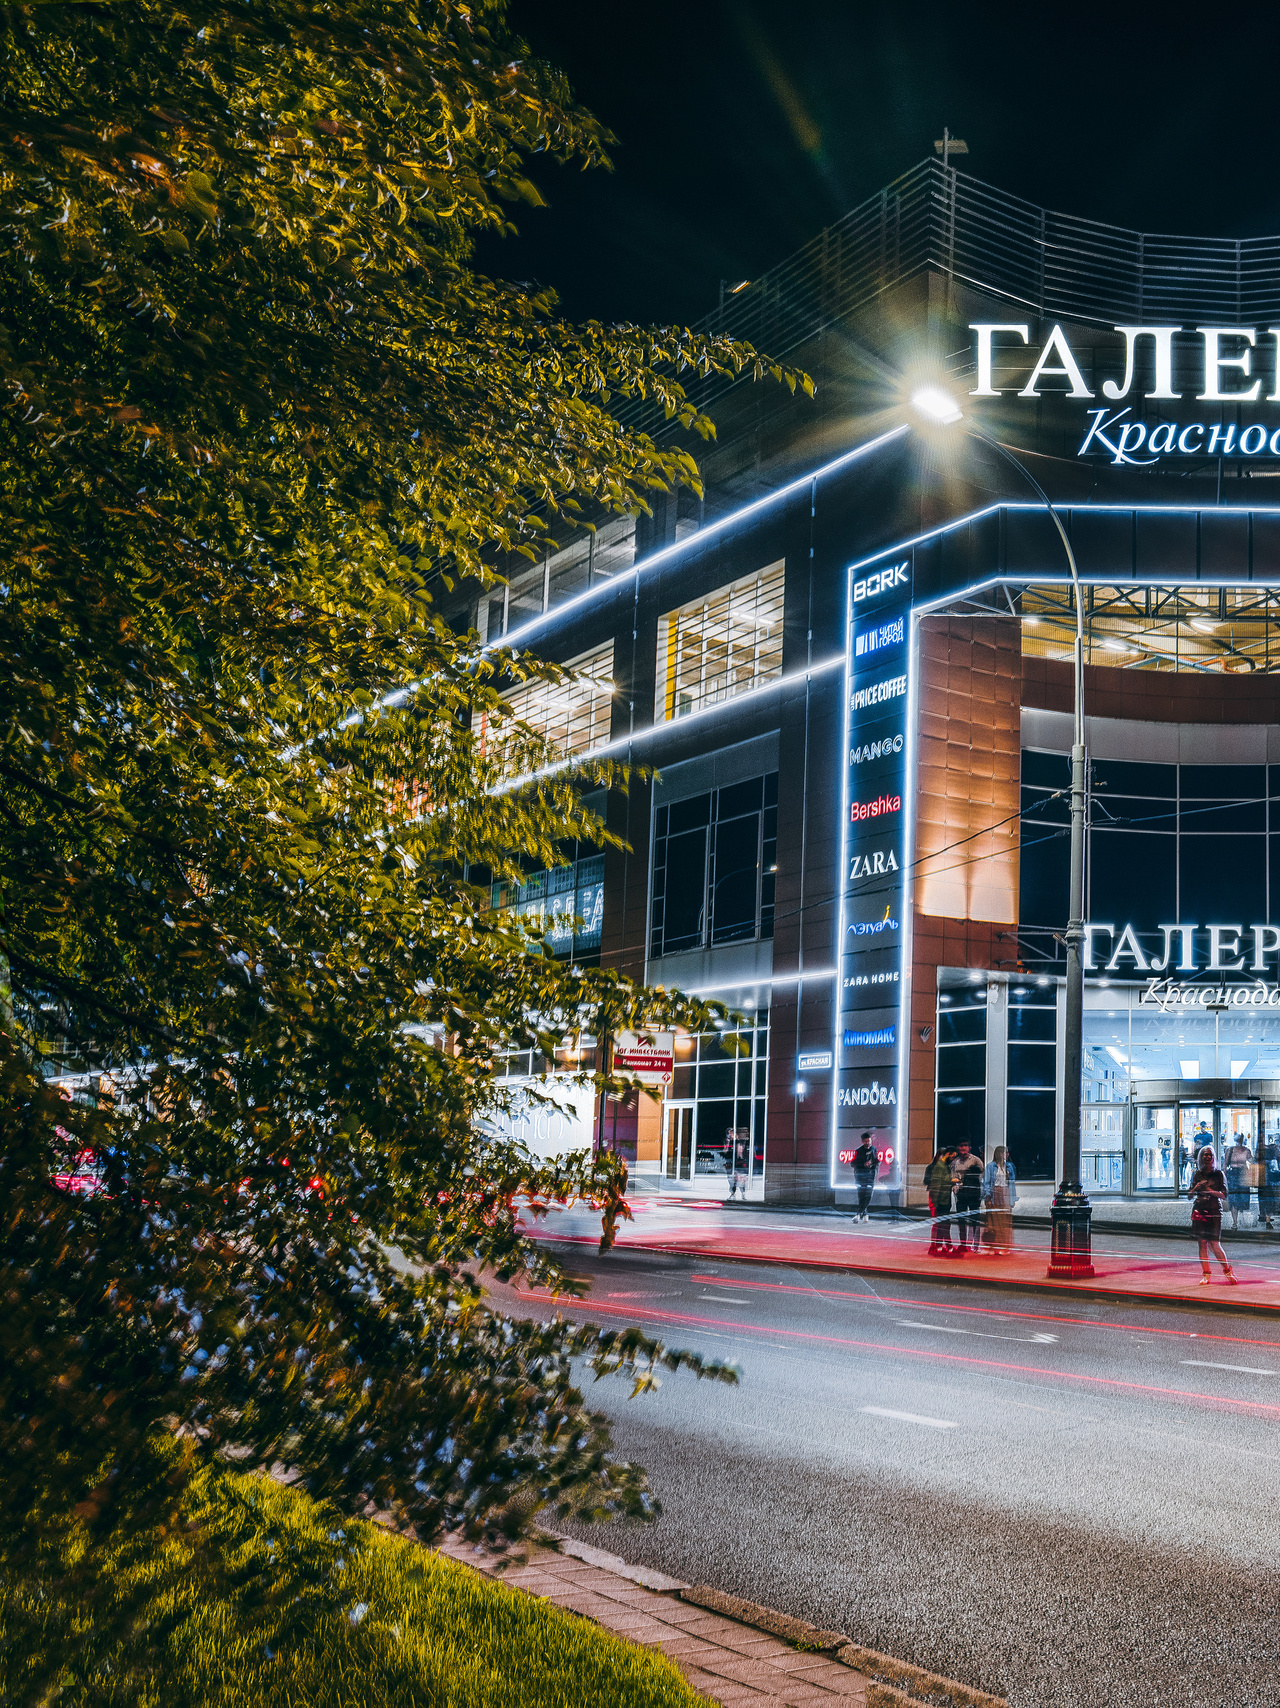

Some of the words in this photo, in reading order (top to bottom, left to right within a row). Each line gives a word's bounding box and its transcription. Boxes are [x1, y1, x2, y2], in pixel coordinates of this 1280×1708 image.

[853, 561, 909, 602] BORK
[879, 616, 904, 636] ЧИТАЙ
[879, 630, 904, 648] ГОРОД
[854, 683, 878, 710] PRICE
[878, 674, 907, 702] COFFEE
[850, 734, 904, 766] MANGO
[850, 794, 901, 822] Bershka
[850, 849, 899, 880] ZARA
[843, 975, 868, 988] ZARA
[871, 971, 900, 984] HOME
[843, 1024, 896, 1047] КИНОМАКС
[838, 1084, 896, 1106] PANDORA
